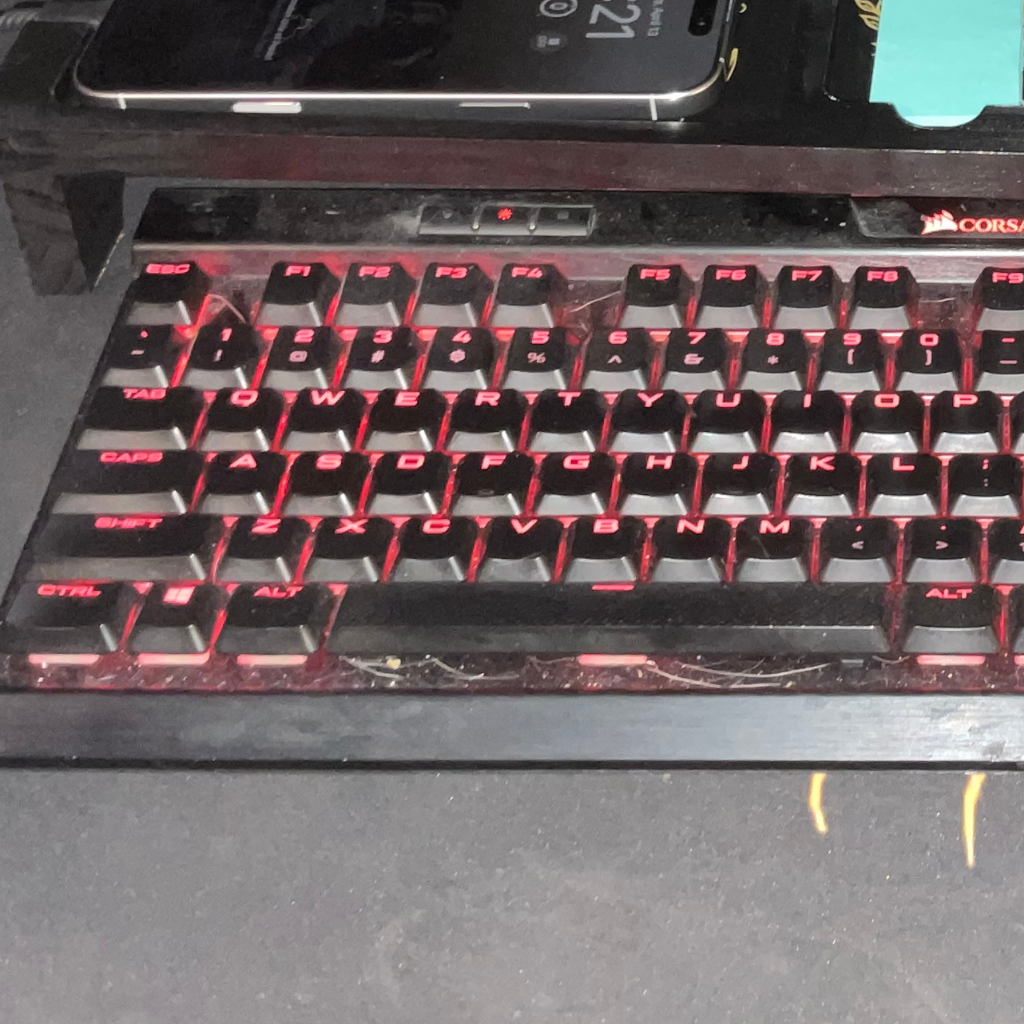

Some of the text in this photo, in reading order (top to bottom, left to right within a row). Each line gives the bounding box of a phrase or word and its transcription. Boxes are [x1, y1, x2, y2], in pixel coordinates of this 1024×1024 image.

[647, 25, 660, 36] 13
[145, 262, 191, 275] ESC
[284, 264, 312, 277] F1
[358, 264, 392, 279] F2
[435, 265, 468, 279] F3
[511, 266, 543, 279] F4
[639, 268, 671, 281] F5
[715, 268, 747, 281] F6
[791, 269, 823, 282] F7
[866, 270, 899, 283] F8
[991, 271, 1024, 284] F9
[221, 327, 233, 342] 1
[293, 327, 315, 344] 2
[372, 328, 394, 344] 3
[451, 329, 472, 344] 4
[531, 330, 550, 345] 5
[608, 330, 628, 345] 6
[687, 331, 707, 345] 7
[765, 331, 785, 346] 8
[842, 332, 862, 347] 9
[919, 332, 940, 347] 0
[527, 352, 546, 364] %
[607, 354, 622, 364] ^
[122, 387, 167, 401] TAB
[229, 388, 259, 407] Q
[310, 388, 346, 406] W
[394, 391, 421, 407] E
[474, 392, 501, 407] R
[557, 391, 582, 407] T
[636, 391, 664, 408] Y
[715, 392, 742, 408] U
[803, 393, 812, 409] I
[873, 392, 901, 409] O
[952, 393, 979, 408] P
[99, 450, 164, 464] CAPS
[228, 452, 257, 469] A
[315, 452, 343, 471] S
[396, 453, 426, 470] D
[480, 454, 507, 470] F
[562, 453, 591, 470] G
[645, 454, 674, 470] H
[732, 454, 750, 470] J
[809, 454, 835, 471] K
[891, 456, 915, 472] L
[94, 516, 163, 530] SHIFT
[251, 517, 282, 535] Z
[334, 517, 368, 534] X
[421, 517, 451, 535] C
[510, 517, 539, 535] V
[592, 517, 620, 534] B
[676, 518, 706, 535] N
[758, 518, 791, 535] M
[36, 583, 102, 598] CTRL
[253, 585, 304, 599] ALT
[925, 587, 973, 600] ALT
